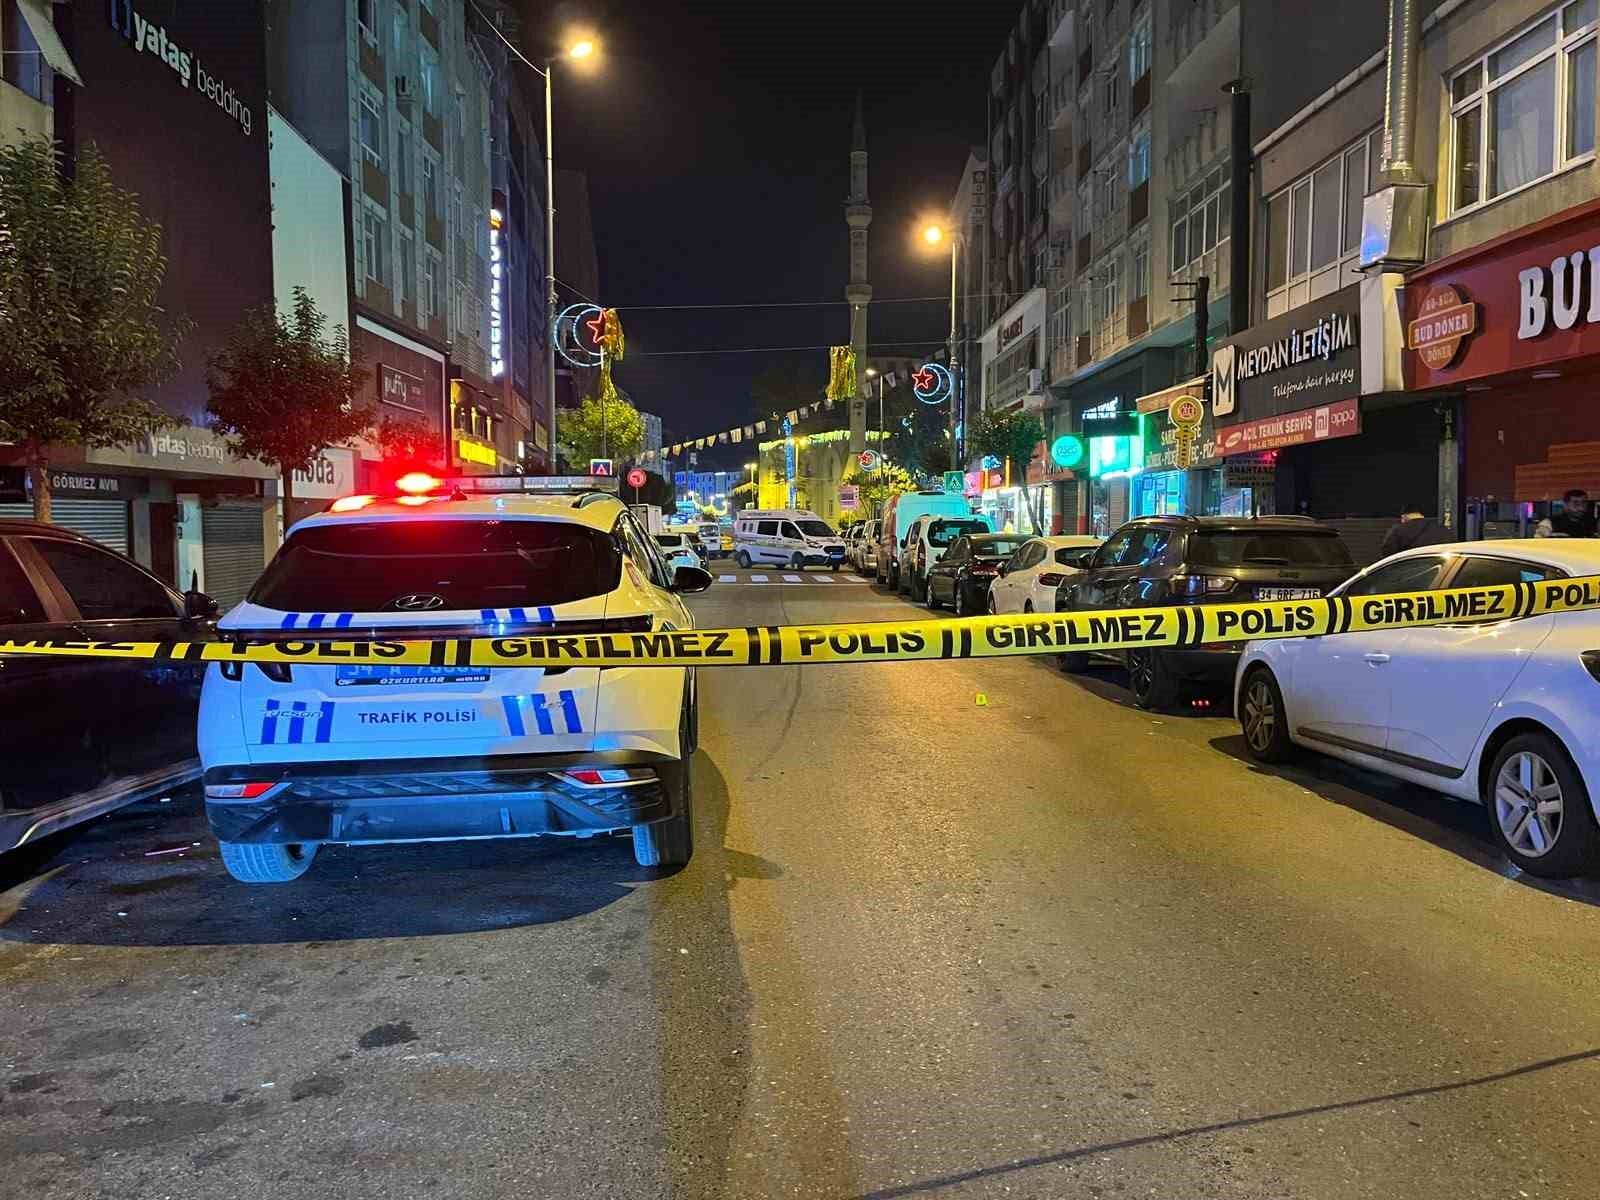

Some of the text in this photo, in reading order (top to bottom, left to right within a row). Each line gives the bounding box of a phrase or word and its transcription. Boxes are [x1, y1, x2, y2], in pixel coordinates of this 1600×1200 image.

[133, 11, 251, 136] yataş bedding
[1518, 246, 1600, 340] BU
[1414, 324, 1433, 344] BUD
[1237, 313, 1352, 380] MEYDAN İLETİŞİM
[1330, 409, 1356, 426] oppo
[151, 434, 186, 460] yataş
[53, 473, 96, 490] GÖRMEZ
[1259, 589, 1271, 600] 34
[1545, 582, 1600, 609] POL
[358, 708, 476, 724] TRAFİK POLİSİ
